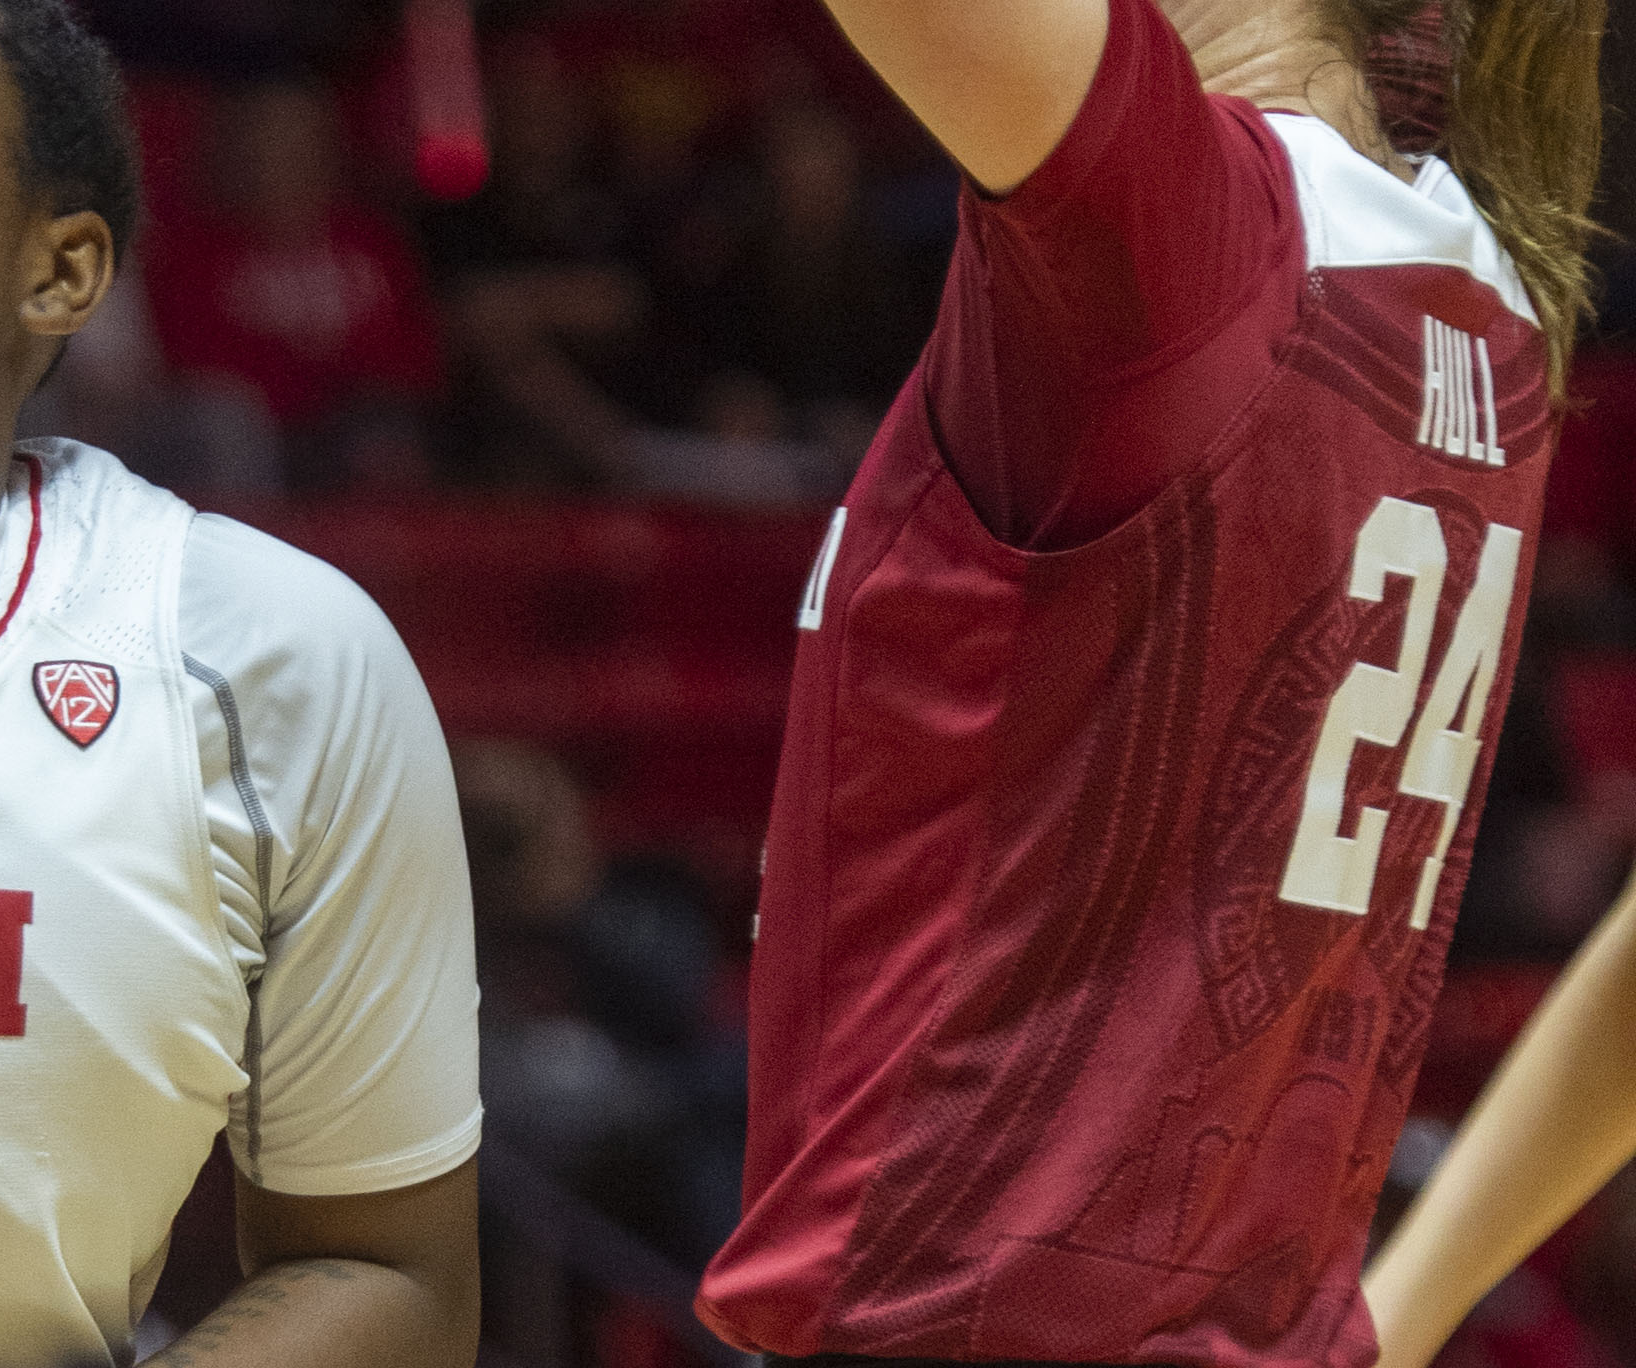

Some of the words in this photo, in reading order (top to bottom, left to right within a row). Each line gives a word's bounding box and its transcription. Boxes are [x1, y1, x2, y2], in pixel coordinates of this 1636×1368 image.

[1417, 313, 1507, 467] HULL
[38, 662, 114, 713] PAC
[60, 695, 102, 728] 12
[1279, 496, 1523, 932] 24
